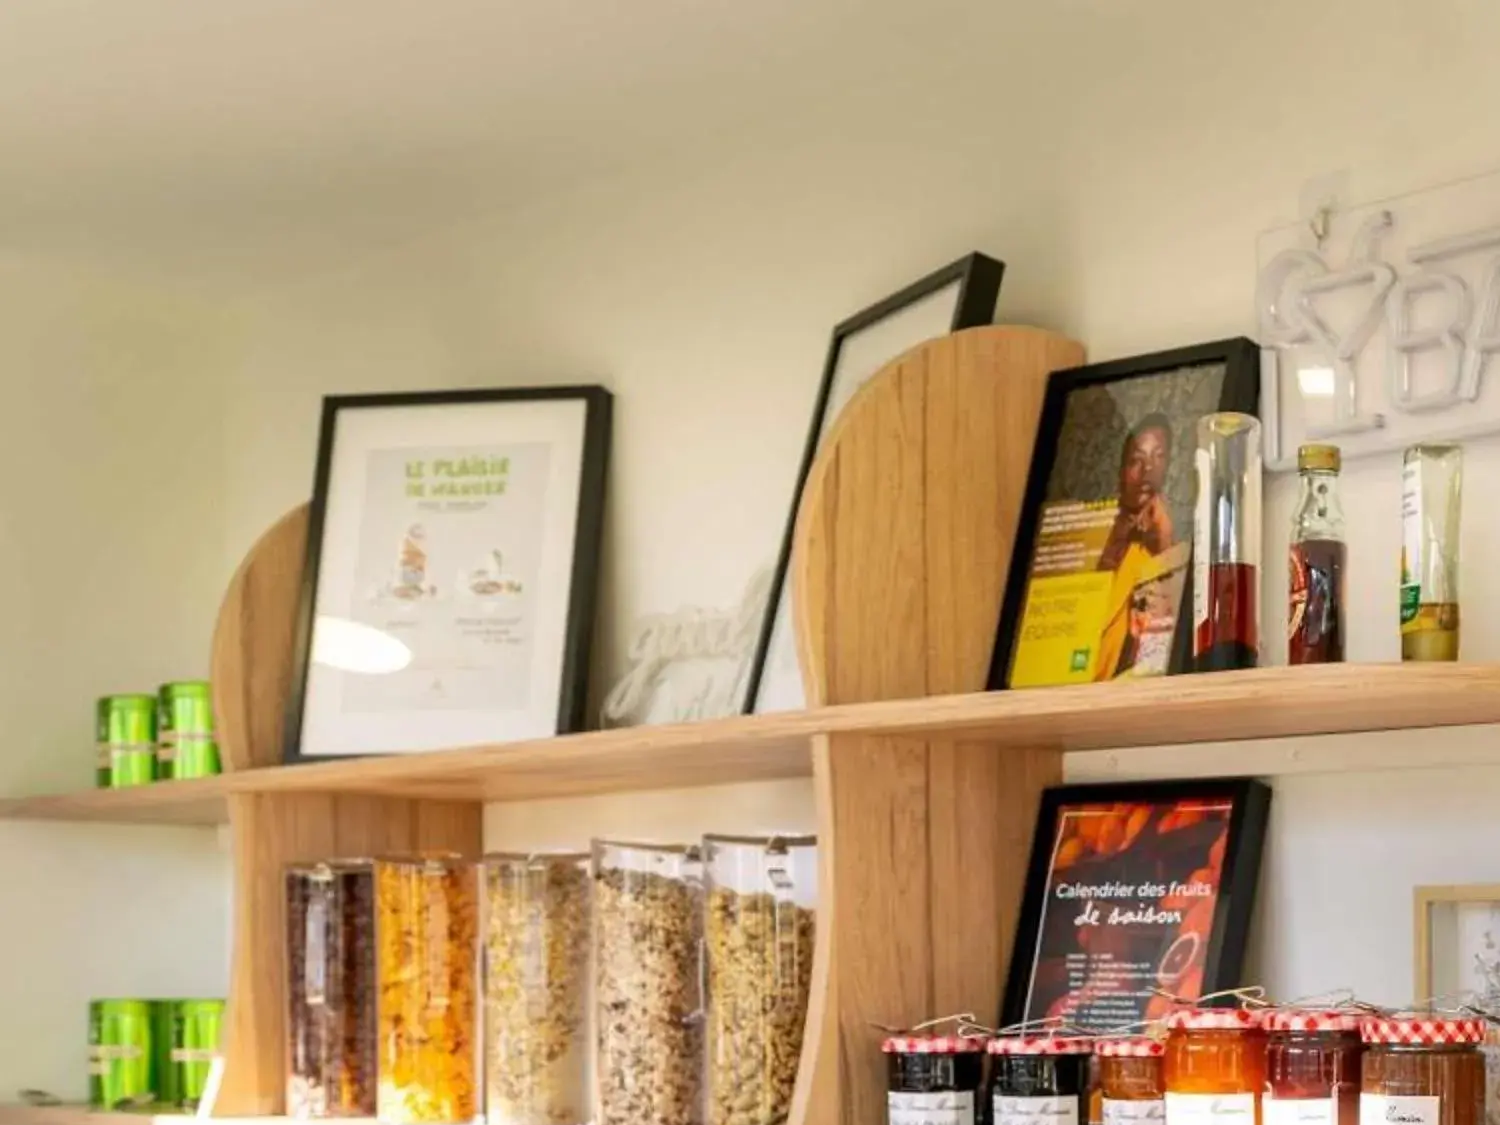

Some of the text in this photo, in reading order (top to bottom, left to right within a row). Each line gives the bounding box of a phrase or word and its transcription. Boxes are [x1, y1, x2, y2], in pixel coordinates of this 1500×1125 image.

[1056, 880, 1211, 899] Calendrier des fruits
[1074, 901, 1182, 926] de saison
